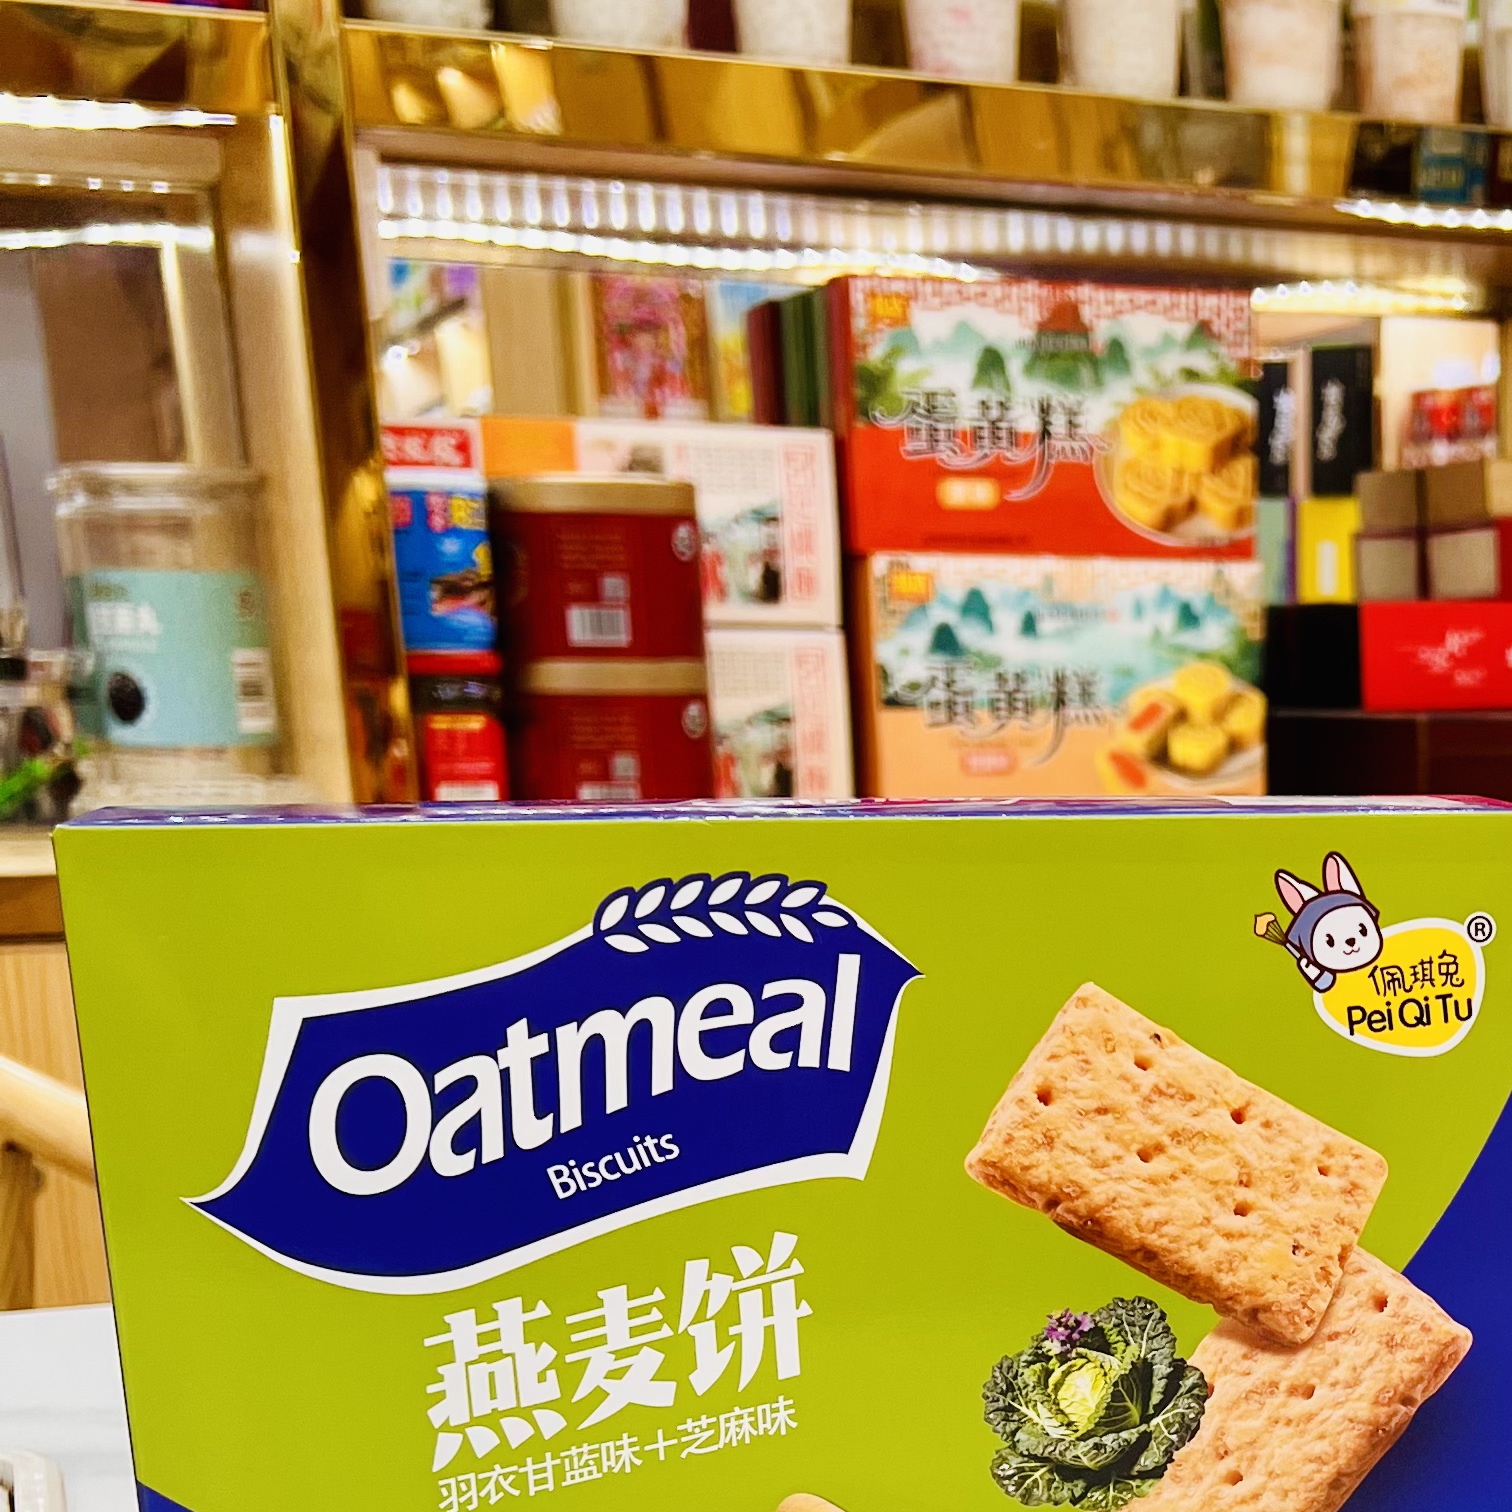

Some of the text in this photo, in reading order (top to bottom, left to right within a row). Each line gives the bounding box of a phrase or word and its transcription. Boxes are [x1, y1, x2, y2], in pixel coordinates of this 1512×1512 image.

[1367, 949, 1465, 997] 佩琪兔
[308, 953, 861, 1196] Oatmeal
[547, 1132, 680, 1200] Biscuits
[423, 1231, 814, 1473] 燕麦饼
